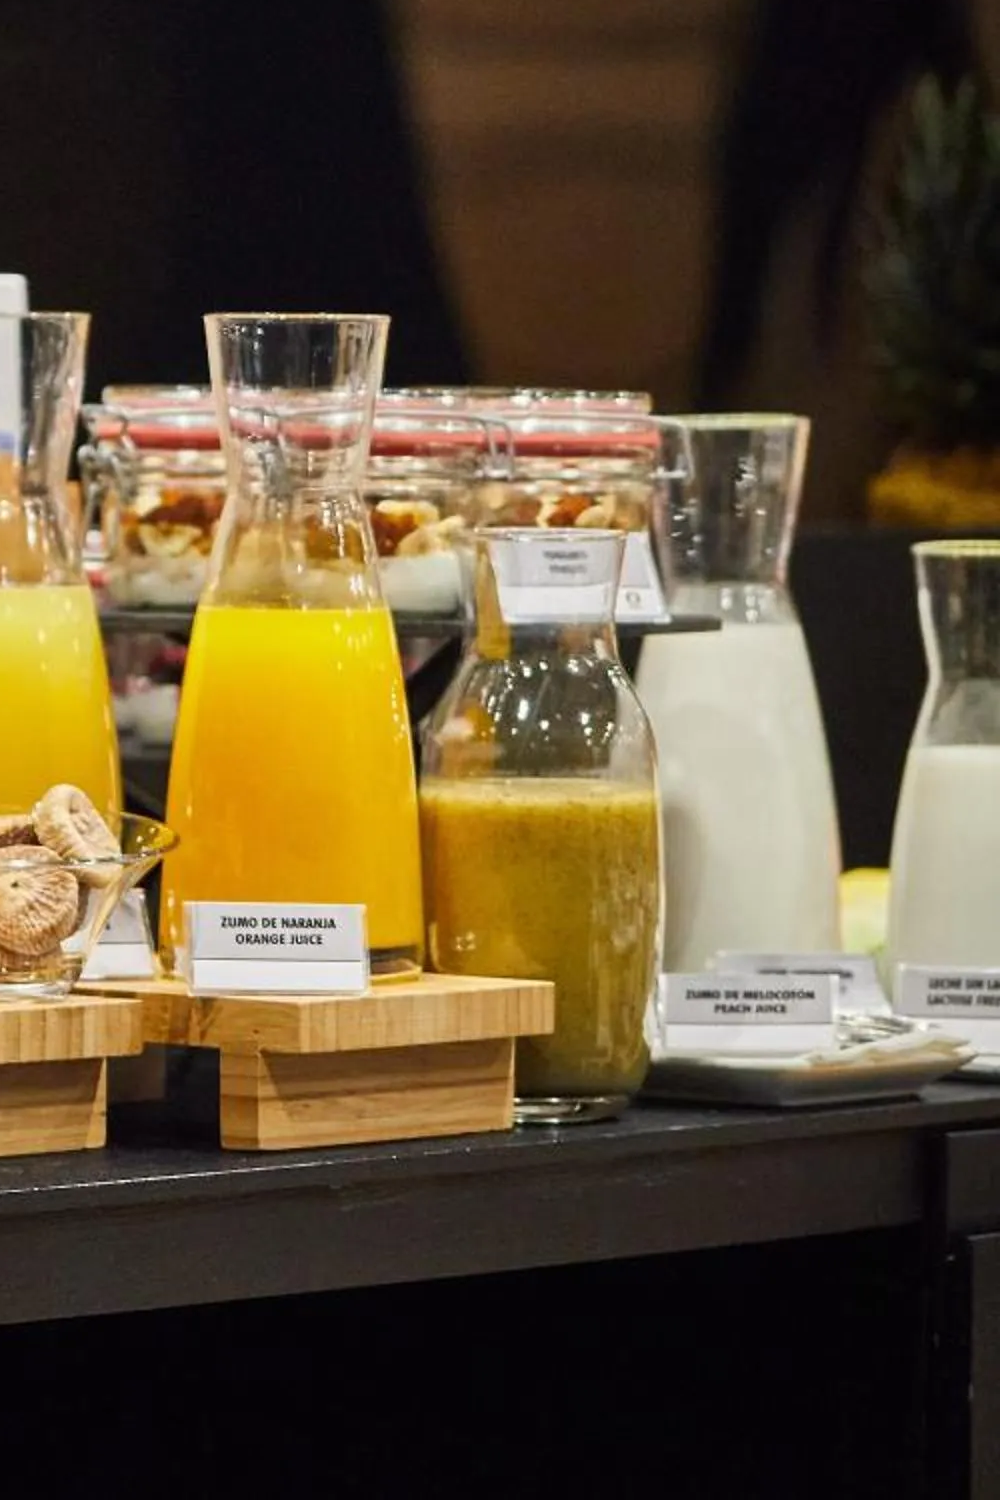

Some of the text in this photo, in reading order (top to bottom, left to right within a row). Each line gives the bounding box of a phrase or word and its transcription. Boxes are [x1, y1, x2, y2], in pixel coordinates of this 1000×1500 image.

[220, 916, 337, 930] ZUMO DE NARANJA
[235, 933, 324, 946] ORANGE JUICE
[685, 989, 721, 1001] ZUMO
[724, 990, 739, 1001] DE
[713, 1003, 751, 1014] PEACH
